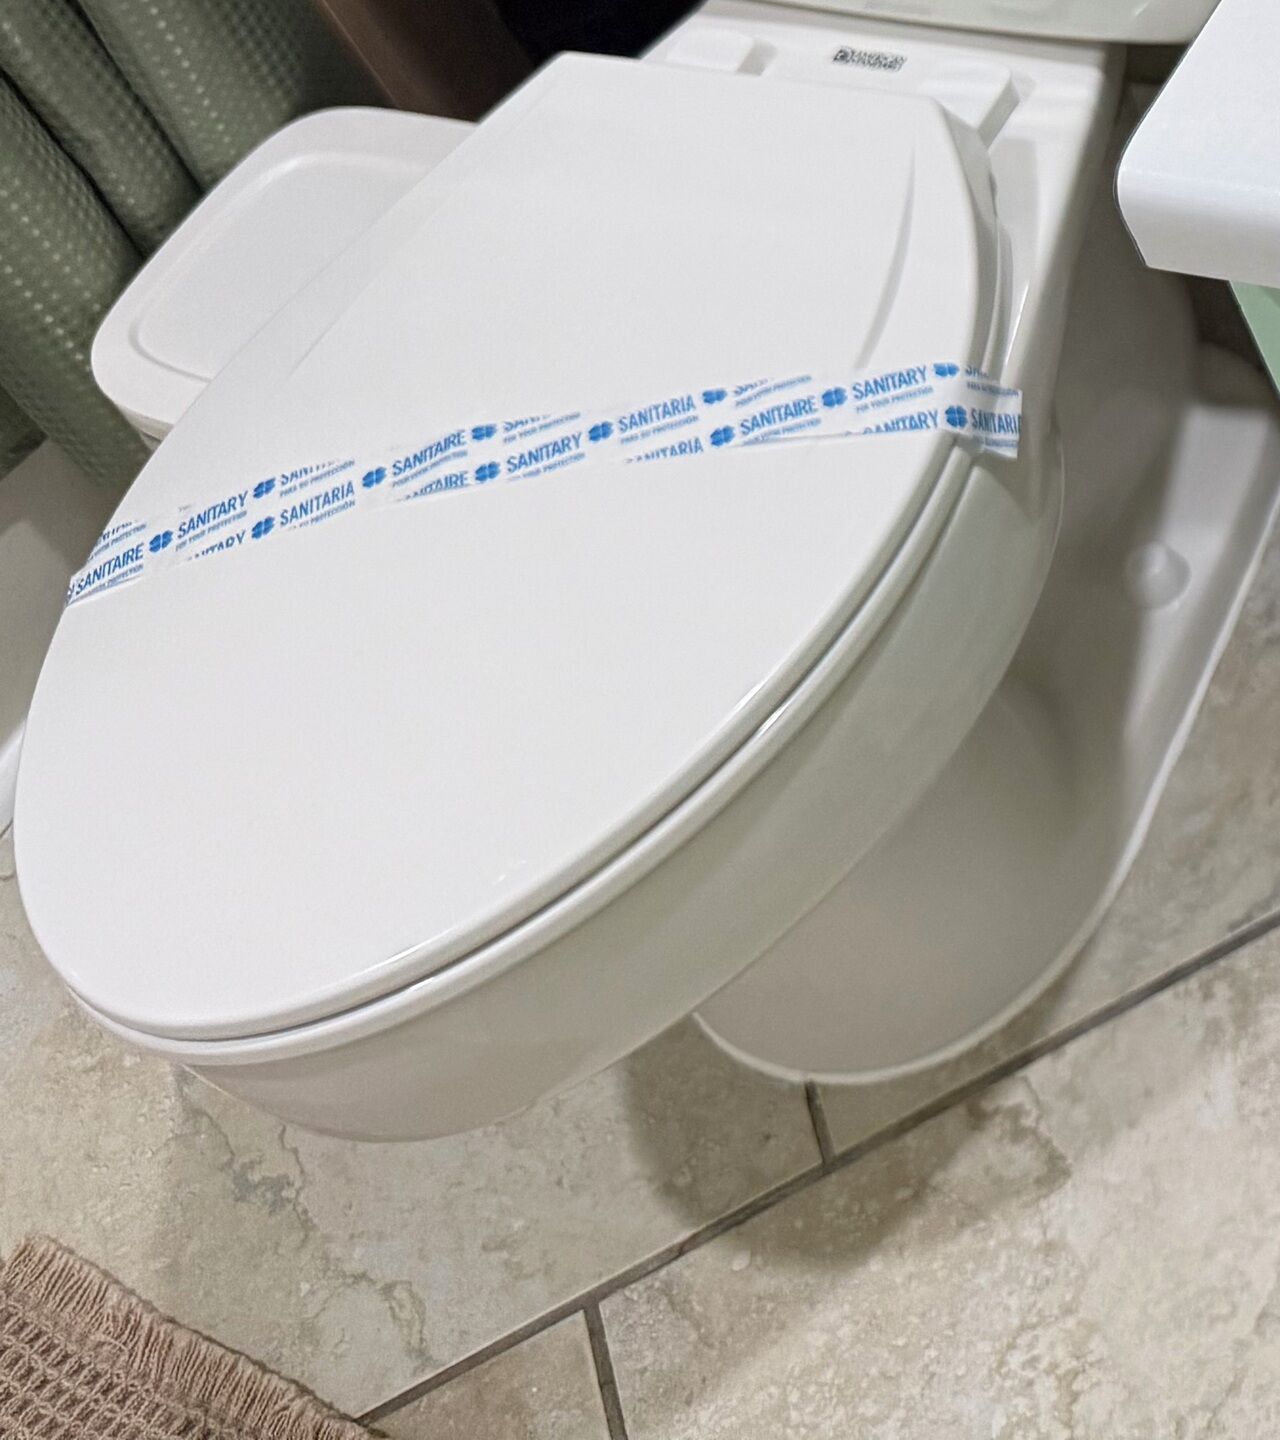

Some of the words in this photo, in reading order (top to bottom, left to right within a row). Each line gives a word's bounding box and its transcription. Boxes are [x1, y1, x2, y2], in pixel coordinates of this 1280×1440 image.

[853, 365, 928, 401] SANITARY
[619, 394, 697, 434] SANITARIA
[740, 394, 819, 436] SANITAIRE
[392, 428, 468, 477] SANITAIRE
[506, 431, 583, 474] SANITARY
[177, 490, 249, 539] SANITARY
[279, 479, 355, 527] SANITARIA
[75, 542, 145, 596] SANITAIRE
